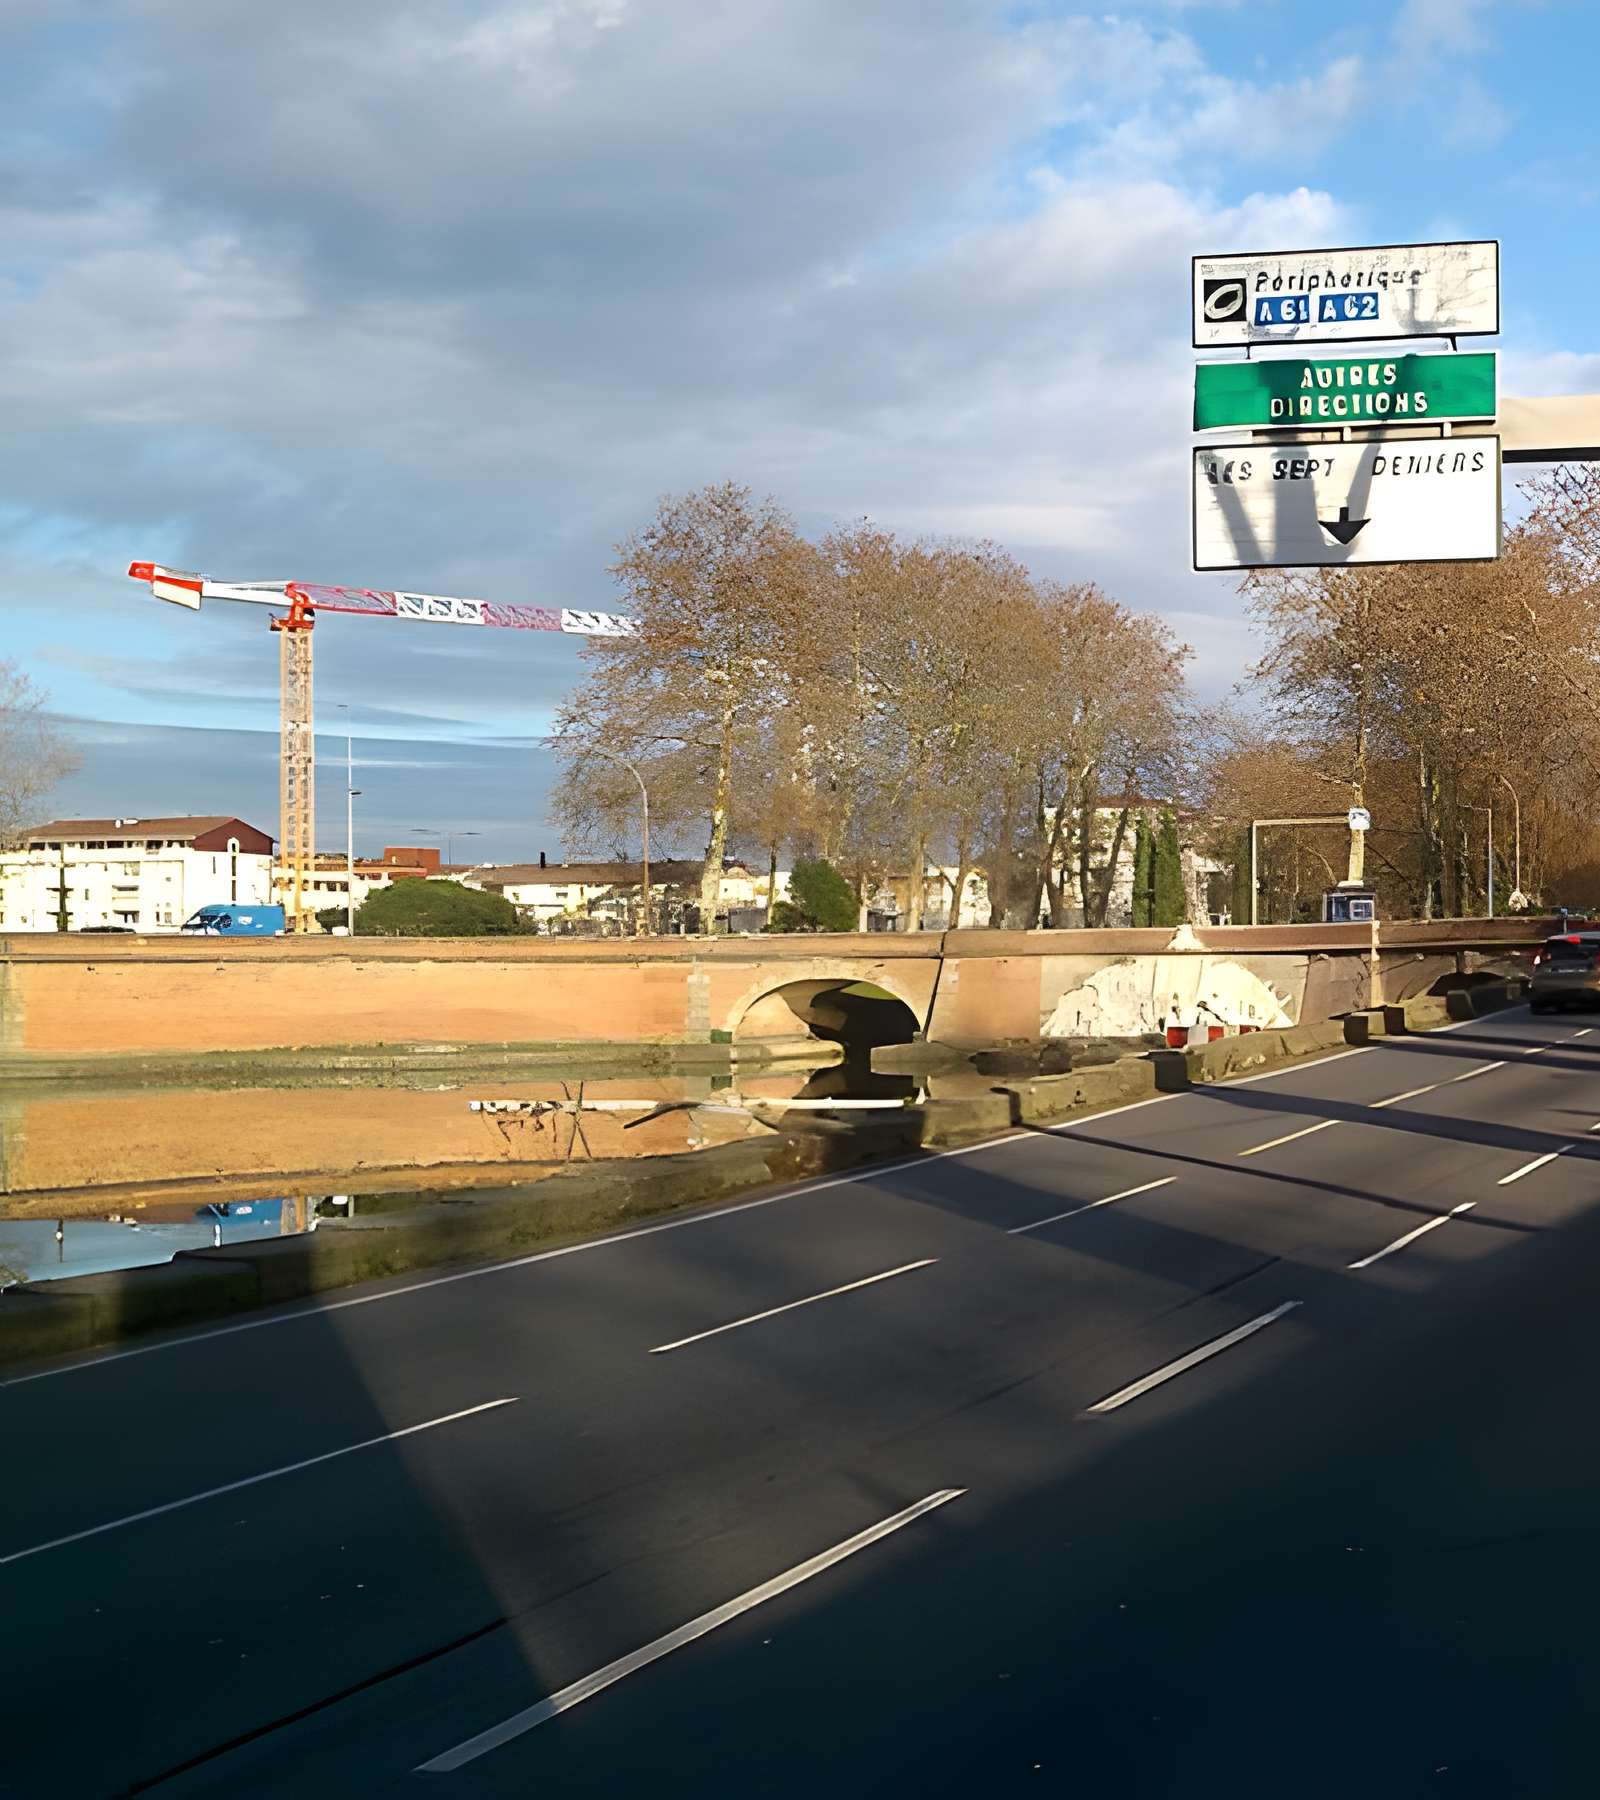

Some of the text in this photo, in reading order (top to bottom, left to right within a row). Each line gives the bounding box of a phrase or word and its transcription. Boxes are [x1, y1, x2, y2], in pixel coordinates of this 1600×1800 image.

[1270, 392, 1429, 418] DIRECTIONS
[1272, 458, 1336, 481] SEPT
[1370, 451, 1485, 477] DENIERS
